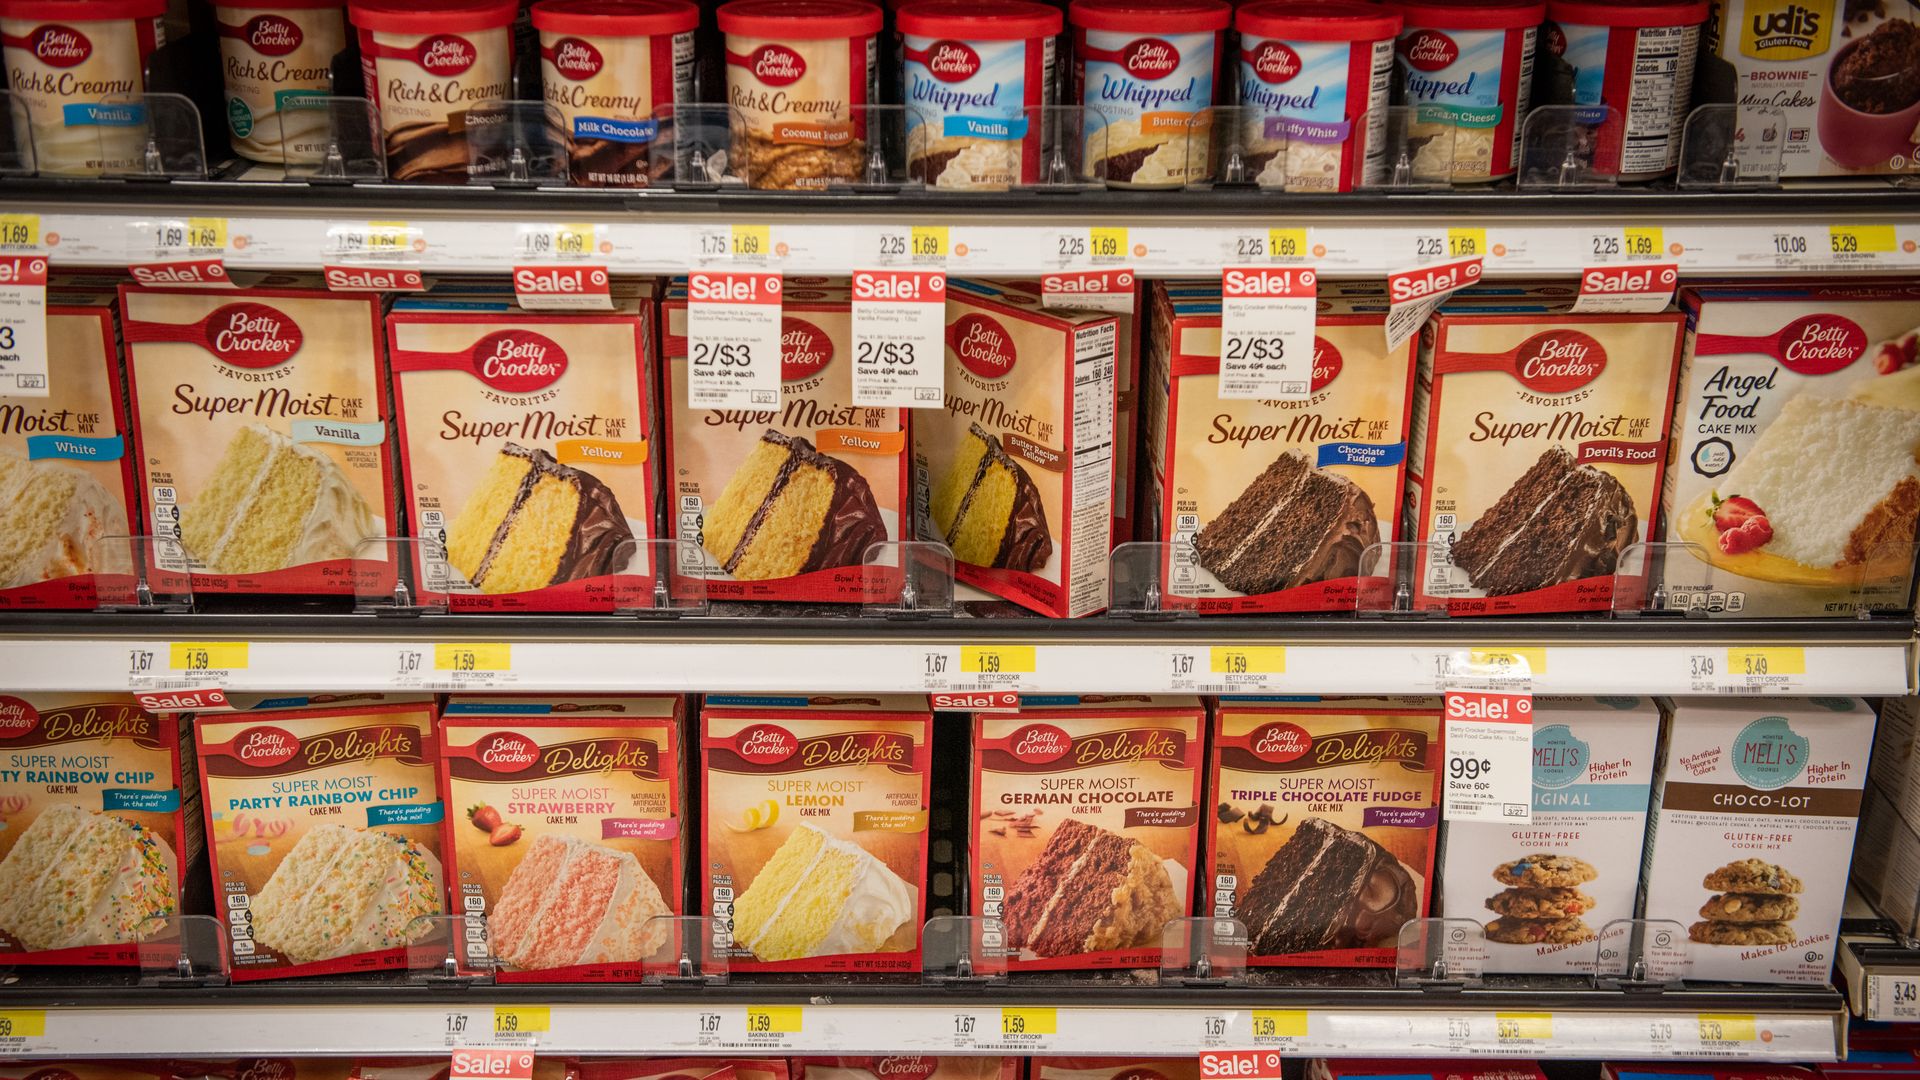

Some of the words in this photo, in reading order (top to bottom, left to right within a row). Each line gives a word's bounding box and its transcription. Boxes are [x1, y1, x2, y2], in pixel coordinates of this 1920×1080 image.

[258, 20, 290, 37] Betty
[1640, 28, 1665, 37] Nutrition
[252, 32, 295, 46] Crocker
[1759, 39, 1788, 50] Gluten
[1789, 40, 1808, 48] Free
[939, 45, 968, 62] Betty
[1138, 45, 1168, 62] Betty
[931, 56, 973, 73] Crocker
[1129, 56, 1173, 72] Crocker
[1636, 64, 1659, 72] Calories
[1751, 71, 1808, 80] BROWNIE
[913, 75, 999, 110] Whipped
[1103, 75, 1195, 109] Whipped
[1772, 91, 1816, 108] Cakes
[1153, 117, 1184, 126] Butter
[1425, 110, 1458, 122] Cream
[1461, 112, 1496, 122] Cheese
[578, 122, 607, 134] Milk
[610, 126, 654, 138] Chocolate
[968, 121, 1008, 135] Vanilla
[2, 225, 28, 242] 1.69
[701, 236, 726, 254] 1.75
[734, 236, 758, 254] 1.69
[880, 238, 905, 254] 2.25
[913, 238, 937, 254] 1.69
[1594, 238, 1619, 254] 2.25
[1626, 238, 1652, 254] 1.69
[1774, 238, 1806, 253] 10.08
[1832, 238, 1857, 253] 5.29
[134, 268, 202, 283] Sale!
[516, 271, 583, 291] Sale!
[1226, 273, 1290, 294] Sale!
[1584, 271, 1651, 292] Sale!
[690, 275, 756, 300] Sale!
[855, 274, 920, 298] Sale!
[1393, 270, 1457, 300] Sale!
[230, 313, 280, 338] Betty
[216, 331, 290, 353] Crocker
[970, 322, 1002, 346] Betty
[1802, 323, 1848, 347] Betty
[498, 340, 545, 359] Betty
[694, 344, 750, 367] 2/$3
[858, 342, 914, 365] 2/$3
[960, 338, 1008, 366] Crocker
[1227, 338, 1283, 360] 2/$3
[1540, 340, 1588, 361] Betty
[1786, 340, 1853, 361] Crocker
[484, 356, 556, 378] Crocker
[1524, 358, 1594, 378] Crocker
[1704, 366, 1778, 398] Angel
[1700, 396, 1759, 420] Food
[605, 418, 626, 429] CAKE
[1698, 424, 1732, 434] CAKE
[1735, 424, 1756, 434] MIX
[315, 426, 360, 439] Vanilla
[606, 429, 621, 438] MIX
[55, 443, 96, 455] White
[840, 436, 880, 449] Yellow
[1011, 437, 1031, 450] Butter
[1032, 443, 1058, 460] Recipe
[580, 446, 623, 458] Yellow
[1021, 450, 1045, 464] Yellow
[1338, 446, 1385, 457] Chocolate
[1347, 454, 1376, 464] Fudge
[1584, 446, 1623, 458] Devil's
[1627, 448, 1656, 458] Food
[158, 489, 172, 498] 160
[130, 653, 153, 670] 1.67
[186, 653, 208, 670] 1.59
[925, 656, 947, 672] 1.67
[978, 656, 999, 672] 1.59
[1691, 658, 1713, 675] 3.49
[1745, 657, 1767, 674] 3.49
[141, 693, 202, 710] Sale!
[936, 696, 995, 707] Sale!
[1448, 696, 1508, 719] Sale!
[44, 710, 149, 745] Delights
[1266, 728, 1299, 743] Betty
[250, 733, 284, 747] Betty
[305, 728, 412, 764] Delights
[492, 738, 526, 753] Betty
[1256, 739, 1305, 754] Crocker
[241, 744, 291, 759] Crocker
[483, 750, 534, 764] Crocker
[802, 736, 904, 769] Delights
[1076, 730, 1176, 768] Delights
[1317, 731, 1417, 767] Delights
[1680, 757, 1689, 765] No
[1691, 747, 1721, 762] Artificial
[1743, 744, 1796, 764] MELI'S
[545, 741, 648, 777] Delights
[1685, 759, 1710, 773] Flavors
[1450, 758, 1491, 780] 99¢
[1693, 766, 1716, 777] Colors
[1807, 765, 1837, 775] Higher
[1841, 762, 1850, 771] In
[26, 771, 109, 783] RAINBOW
[115, 772, 155, 783] CHIP
[272, 781, 318, 793] SUPER
[324, 776, 373, 789] MOIST
[1808, 773, 1846, 784] Protein
[230, 797, 280, 810] PARTY
[289, 792, 372, 807] RAINBOW
[378, 786, 418, 801] CHIP
[512, 788, 555, 800] SUPER
[561, 788, 609, 800] MOIST
[786, 795, 844, 806] LEMON
[1001, 793, 1075, 805] GERMAN
[1080, 791, 1173, 804] CHOCOLATE
[1231, 790, 1277, 801] TRIPLE
[1282, 791, 1368, 802] CHOCOLATE
[1373, 792, 1421, 802] FUDGE
[1714, 793, 1810, 808] CHOCO-LOT
[310, 807, 328, 816] CAKE
[330, 806, 342, 814] MIX
[508, 802, 615, 814] STRAWBERRY
[1308, 804, 1325, 812] CAKE
[1328, 804, 1343, 812] MIX
[1375, 810, 1393, 818] There's
[1395, 810, 1425, 818] pudding
[546, 816, 563, 824] CAKE
[565, 816, 578, 824] MIX
[1724, 833, 1792, 842] GLUTEN-FREE
[232, 896, 246, 904] 160
[1741, 949, 1773, 961] Makes
[1791, 933, 1830, 950] Cookies
[1894, 984, 1916, 1000] 3.43
[446, 1016, 467, 1031] 1.67
[496, 1016, 517, 1030] 1.59
[954, 1017, 975, 1032] 1.67
[1003, 1017, 1024, 1032] 1.59
[1651, 1024, 1671, 1039] 5.79
[1700, 1024, 1722, 1039] 5.79
[454, 1053, 510, 1074] Sale!
[1203, 1054, 1259, 1075] Sale!
